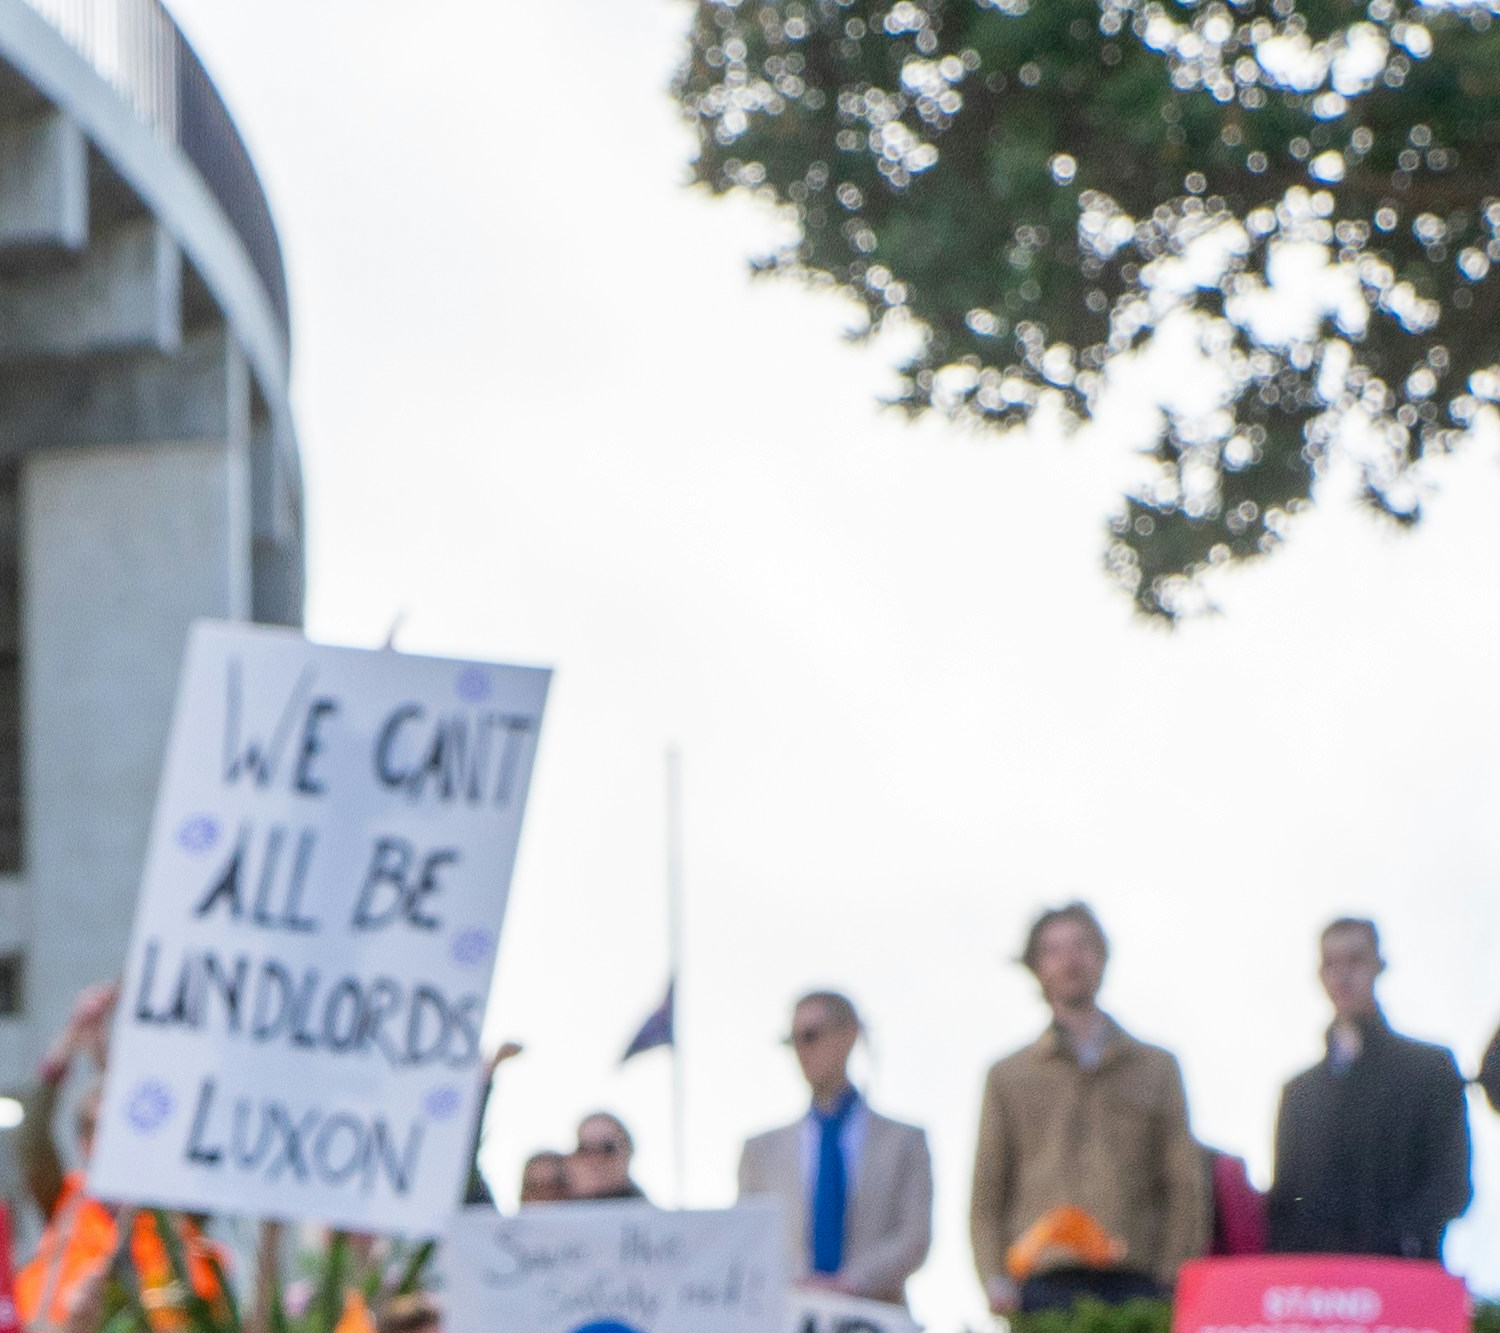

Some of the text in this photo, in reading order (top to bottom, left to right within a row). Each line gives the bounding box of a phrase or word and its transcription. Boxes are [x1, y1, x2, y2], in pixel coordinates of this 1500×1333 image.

[222, 652, 341, 798] WE
[194, 822, 460, 932] ALL BE
[133, 936, 483, 1072] LANDLORDS
[184, 1072, 427, 1198] LUXON
[1264, 1289, 1380, 1321] STAND
